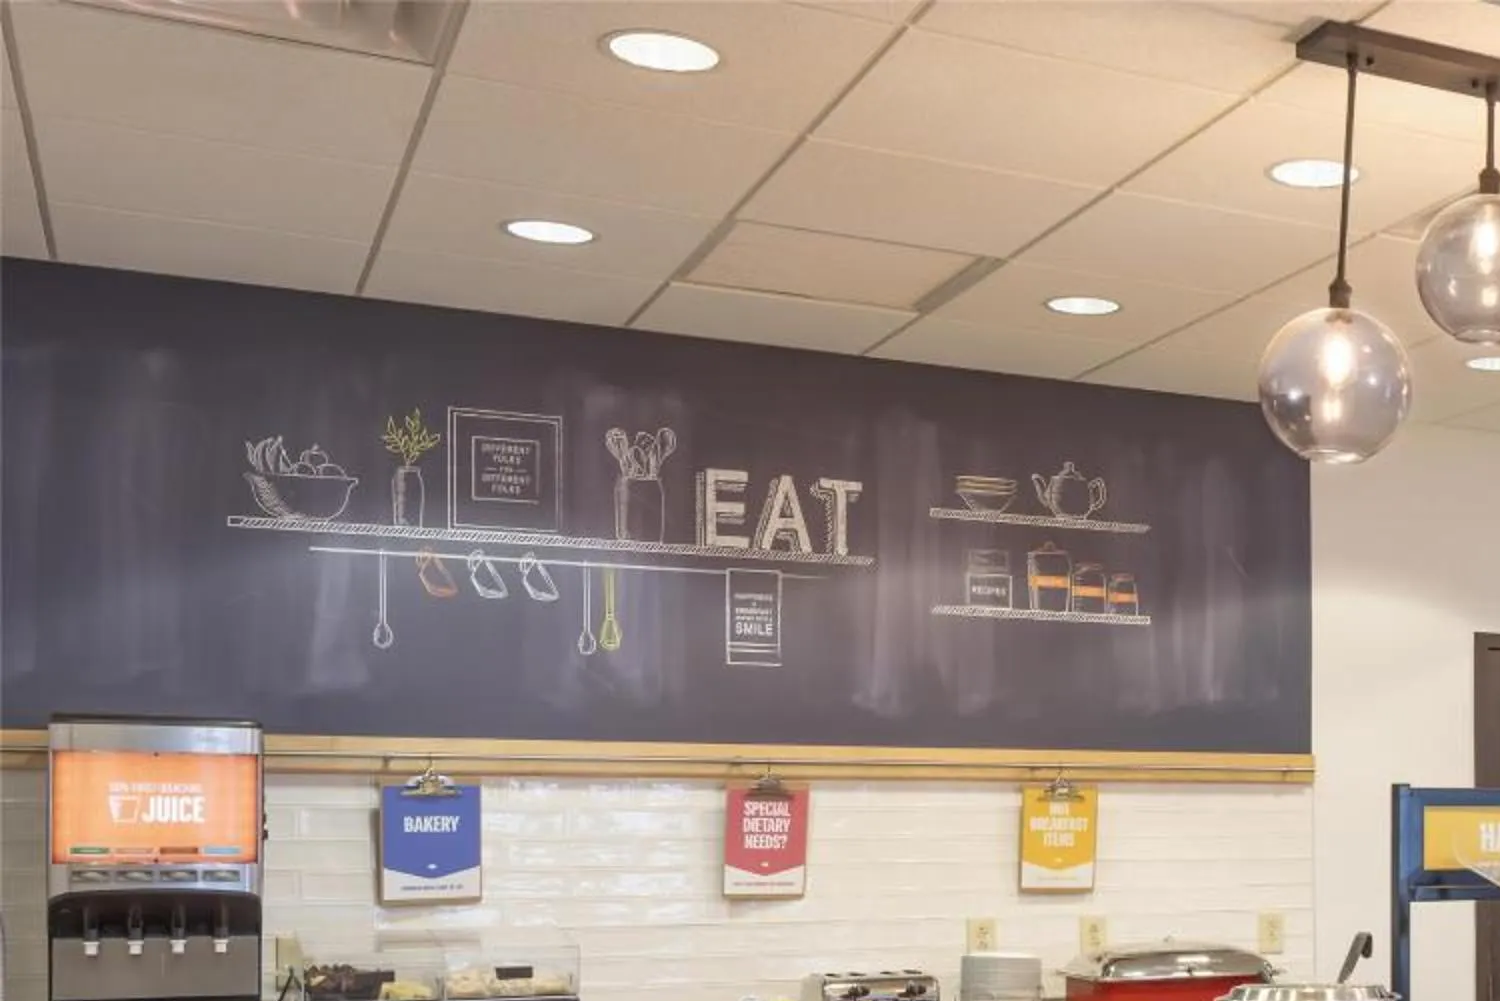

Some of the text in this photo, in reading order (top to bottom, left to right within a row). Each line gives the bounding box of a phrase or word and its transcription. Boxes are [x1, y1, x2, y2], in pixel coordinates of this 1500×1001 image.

[696, 468, 863, 555] EAT
[735, 622, 773, 637] SMILE
[141, 796, 206, 823] JUICE
[743, 800, 792, 817] SPECIAL
[403, 815, 460, 833] BAKERY
[743, 817, 791, 833] DIETARY
[744, 834, 788, 849] NEEDS?
